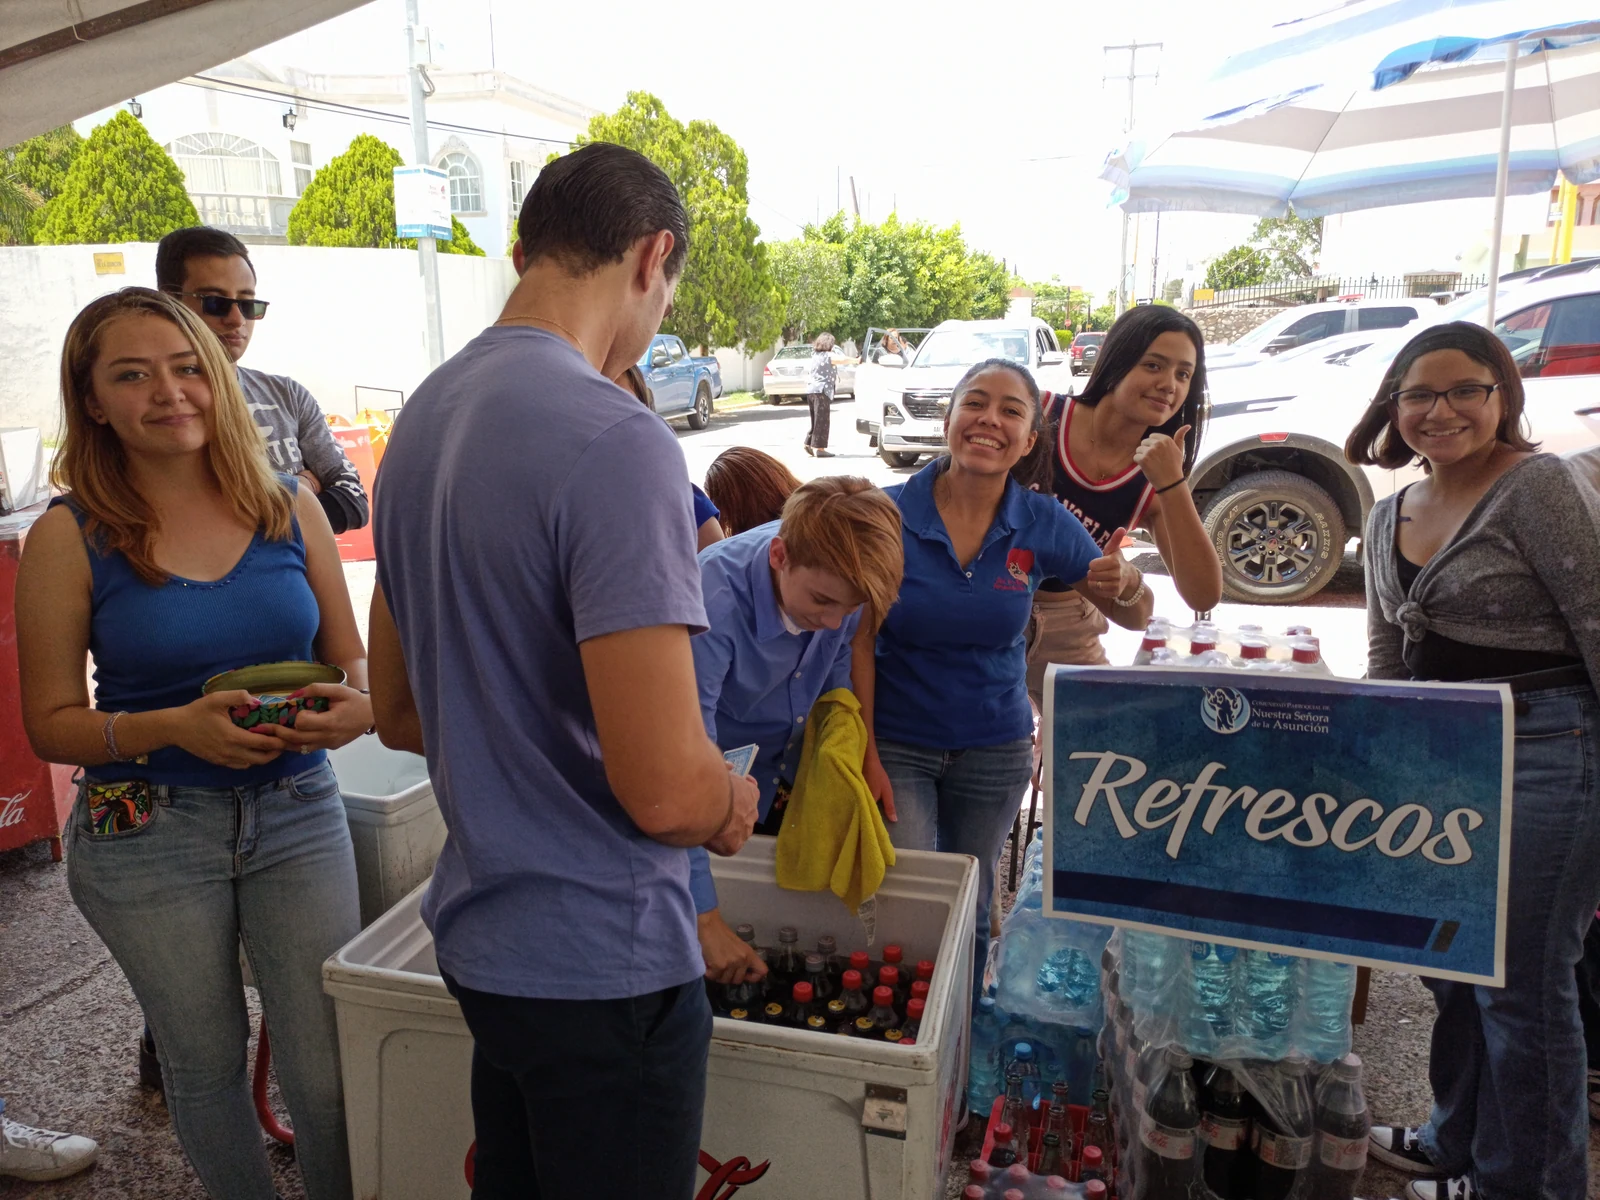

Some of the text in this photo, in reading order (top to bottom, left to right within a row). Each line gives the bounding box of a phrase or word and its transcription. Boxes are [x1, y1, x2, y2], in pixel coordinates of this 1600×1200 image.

[1315, 512, 1331, 560] MAXXIS
[1251, 708, 1329, 723] Nuestra Señora
[1273, 720, 1329, 734] Asunción
[1068, 750, 1484, 865] Refrescos
